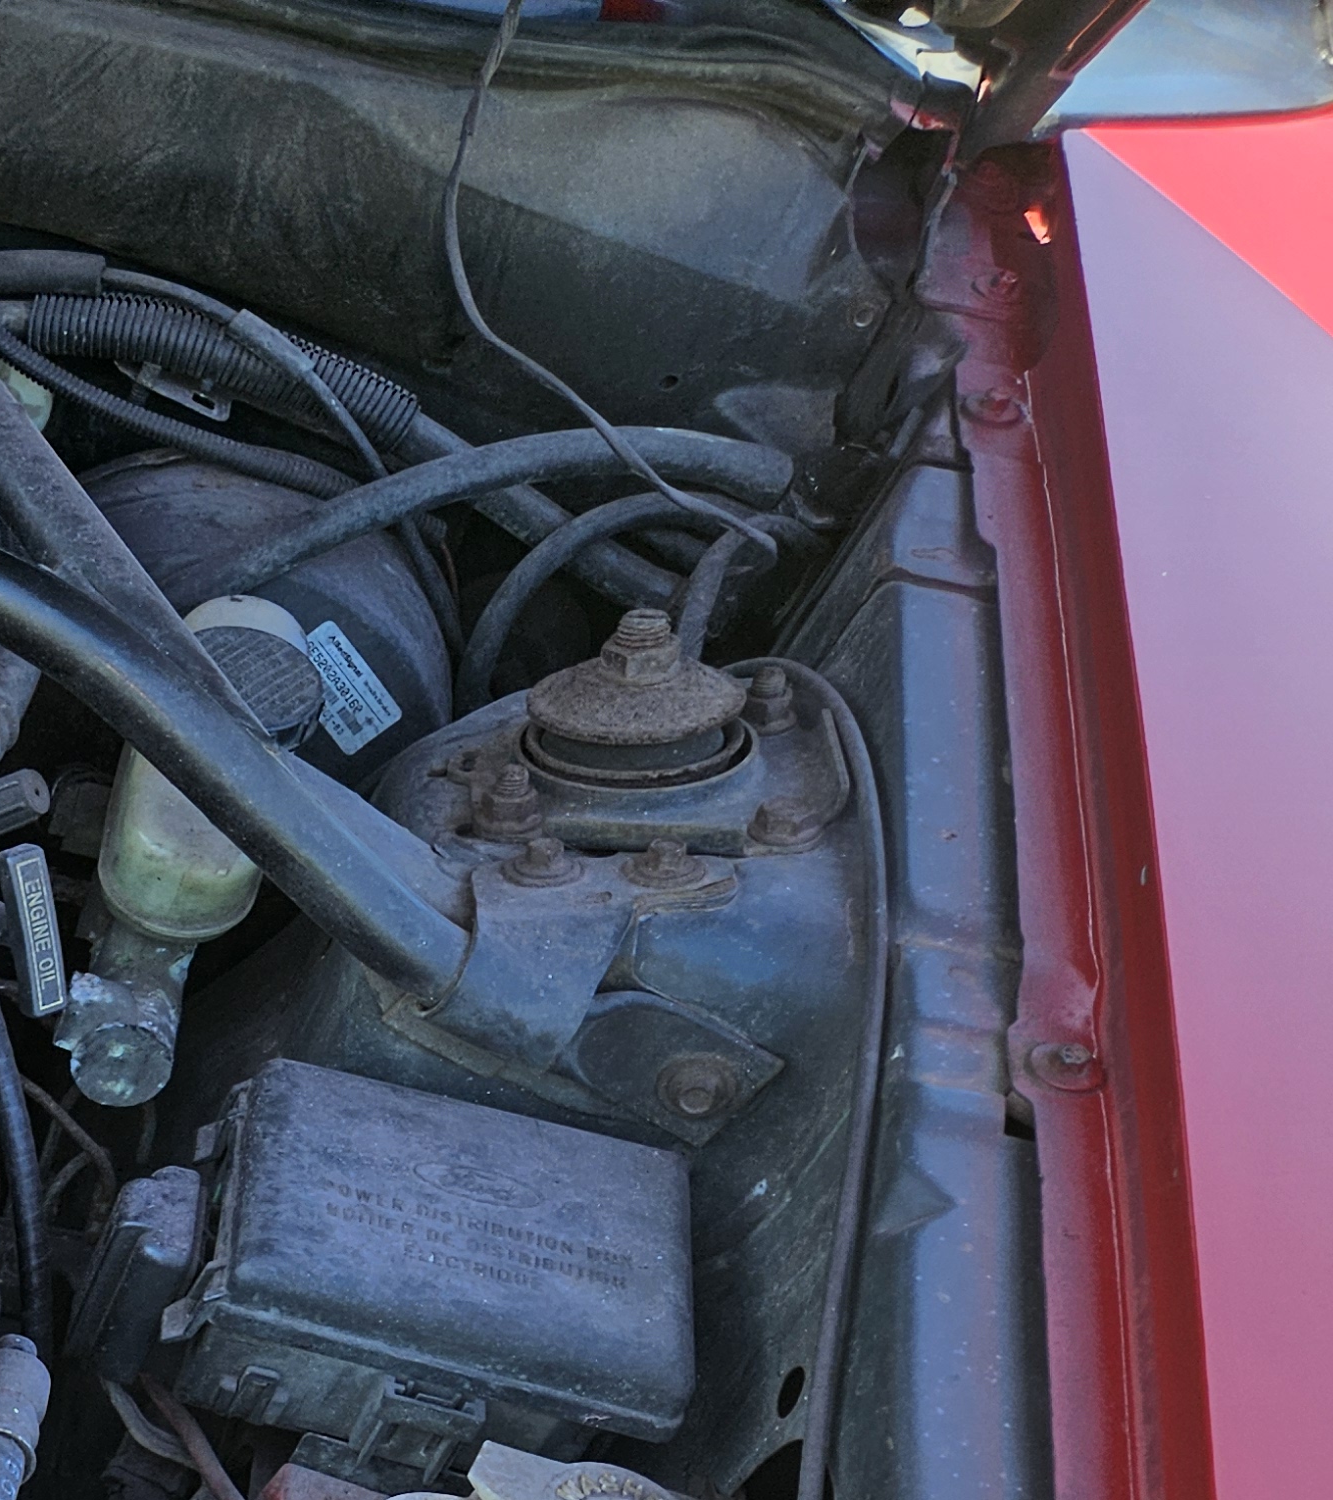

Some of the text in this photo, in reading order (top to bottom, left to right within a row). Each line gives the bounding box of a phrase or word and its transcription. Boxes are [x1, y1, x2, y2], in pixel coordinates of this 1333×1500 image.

[25, 878, 56, 990] ENGINE OIL
[415, 1198, 575, 1256] DISTRIBUTION
